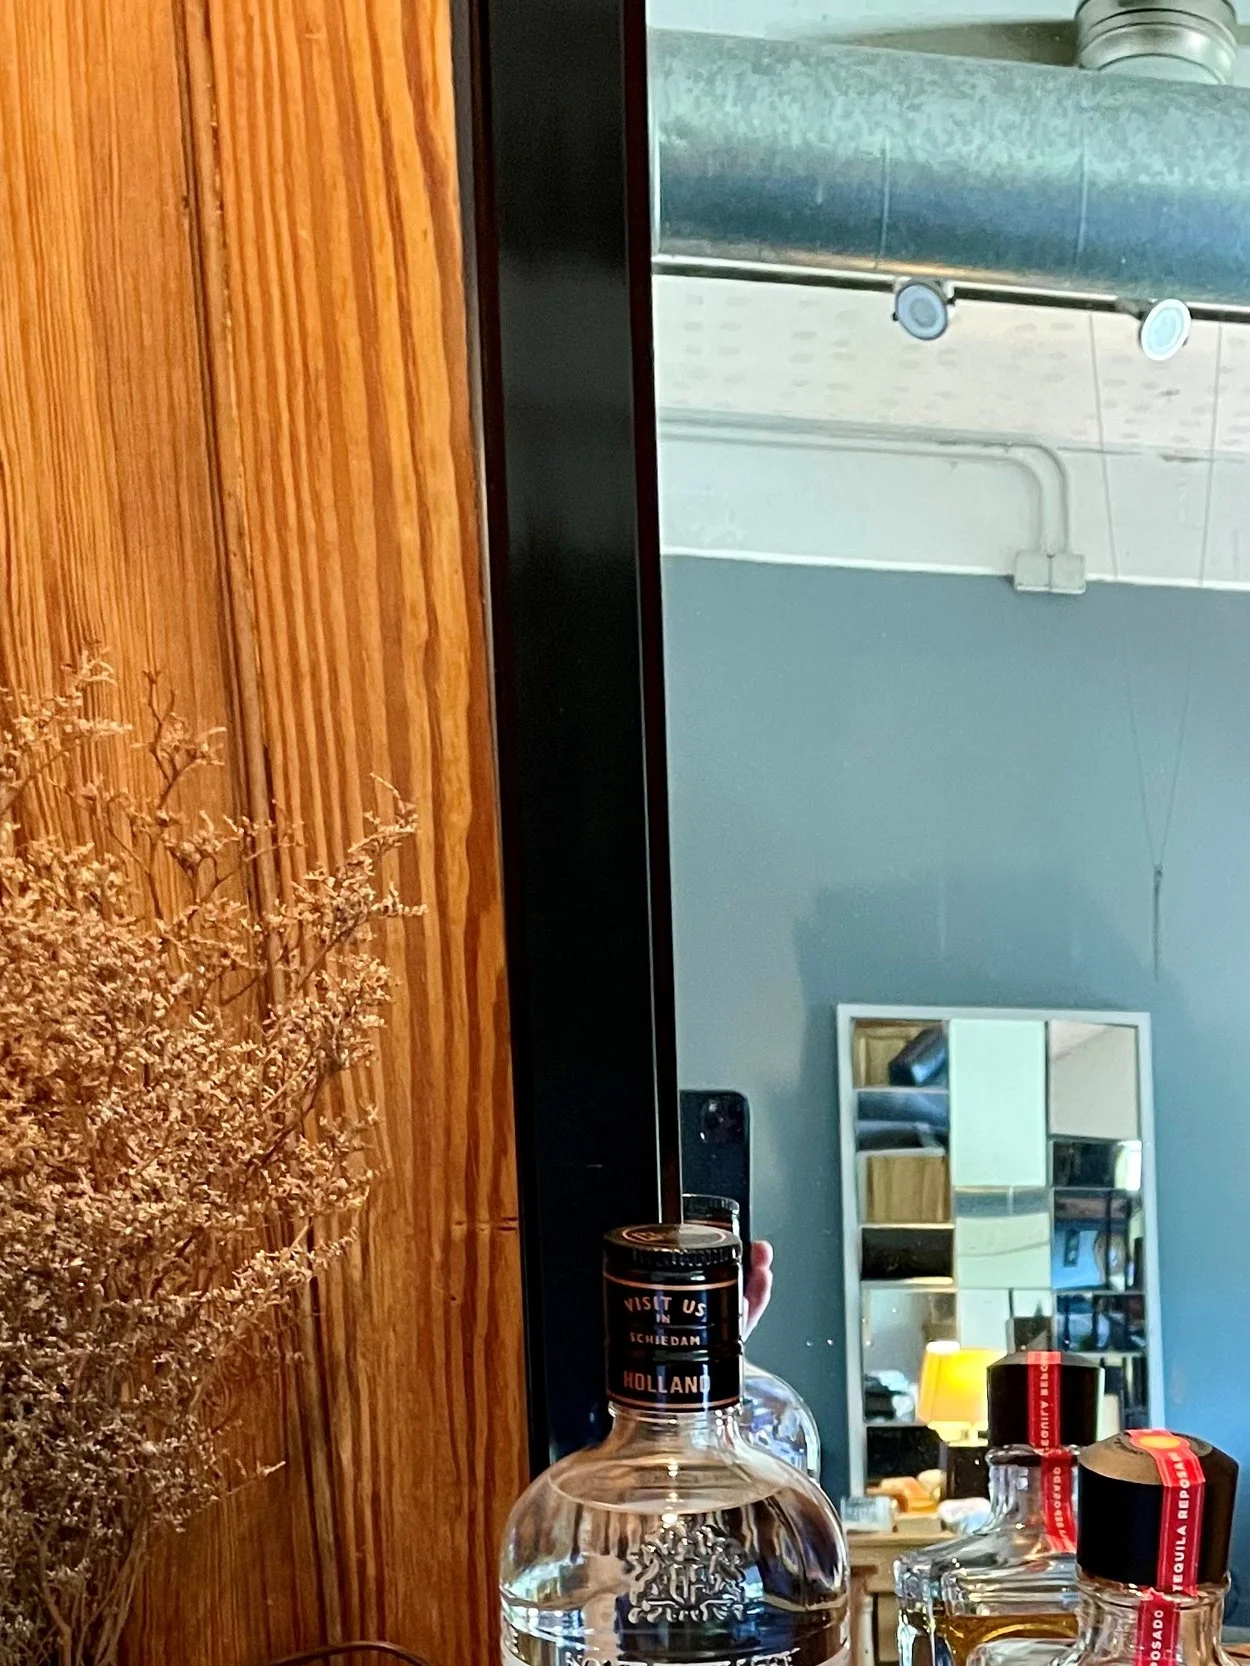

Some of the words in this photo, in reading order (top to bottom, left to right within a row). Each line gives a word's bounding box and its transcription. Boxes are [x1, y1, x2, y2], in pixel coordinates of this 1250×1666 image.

[624, 1296, 672, 1312] VISIT
[682, 1299, 707, 1317] US
[656, 1314, 670, 1323] IN
[630, 1332, 700, 1346] SCHIEDAM
[623, 1371, 711, 1394] HOLLAND
[1173, 1525, 1188, 1592] TEQUILA
